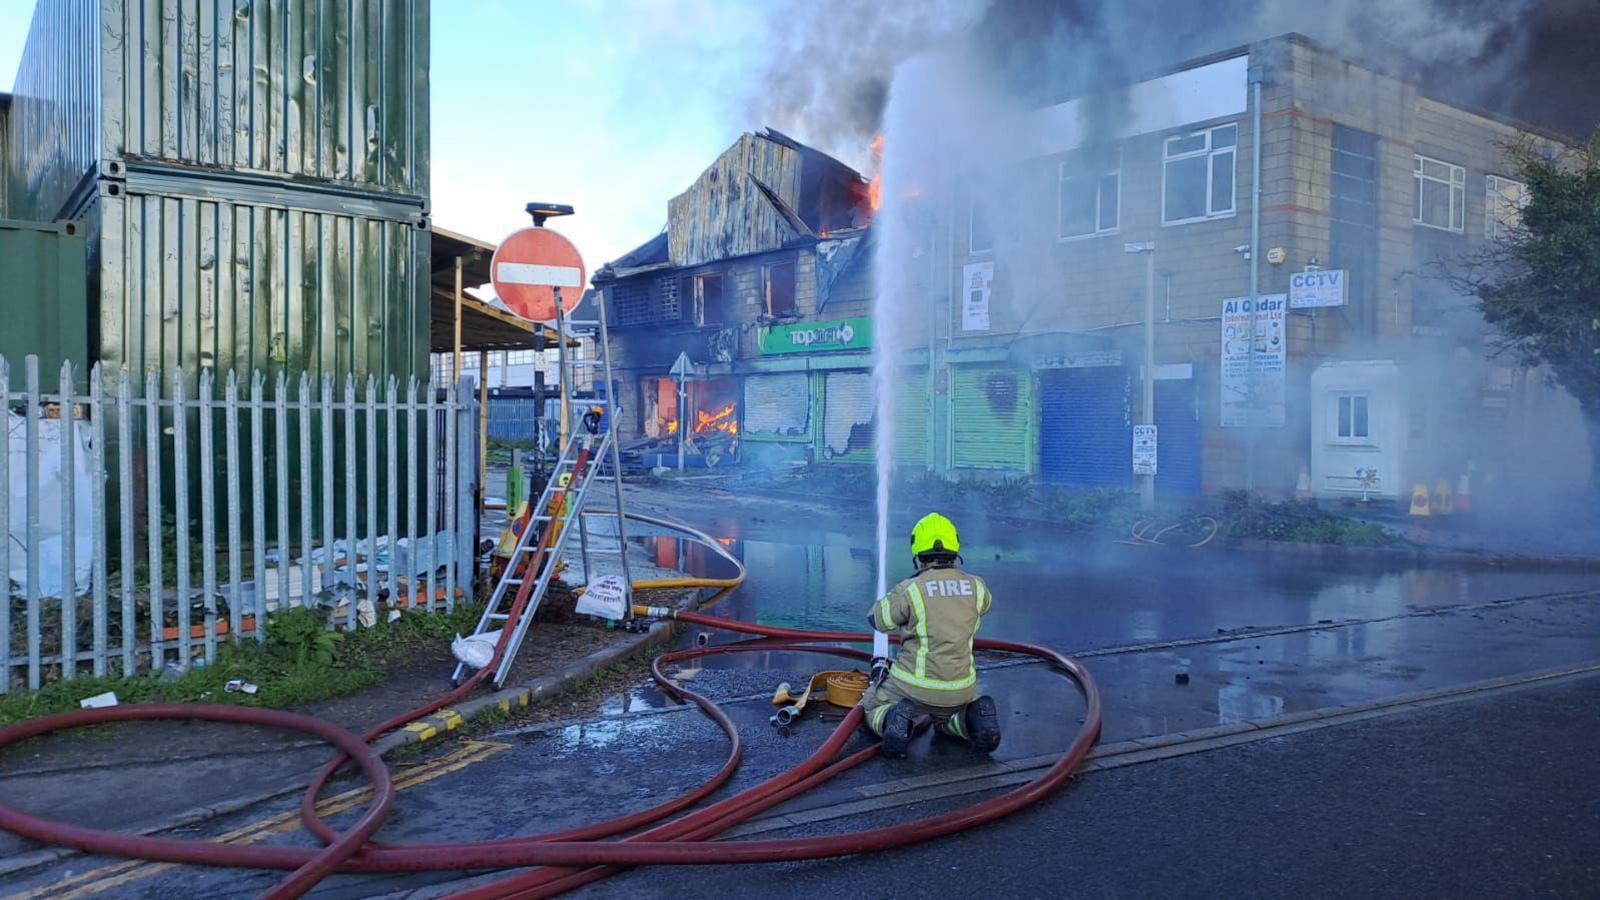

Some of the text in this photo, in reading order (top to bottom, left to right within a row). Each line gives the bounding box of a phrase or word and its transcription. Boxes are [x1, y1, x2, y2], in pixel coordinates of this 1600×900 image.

[1293, 271, 1338, 287] CCTV
[1225, 301, 1238, 313] Al
[1135, 426, 1155, 434] CCTV
[927, 579, 973, 597] FIRE
